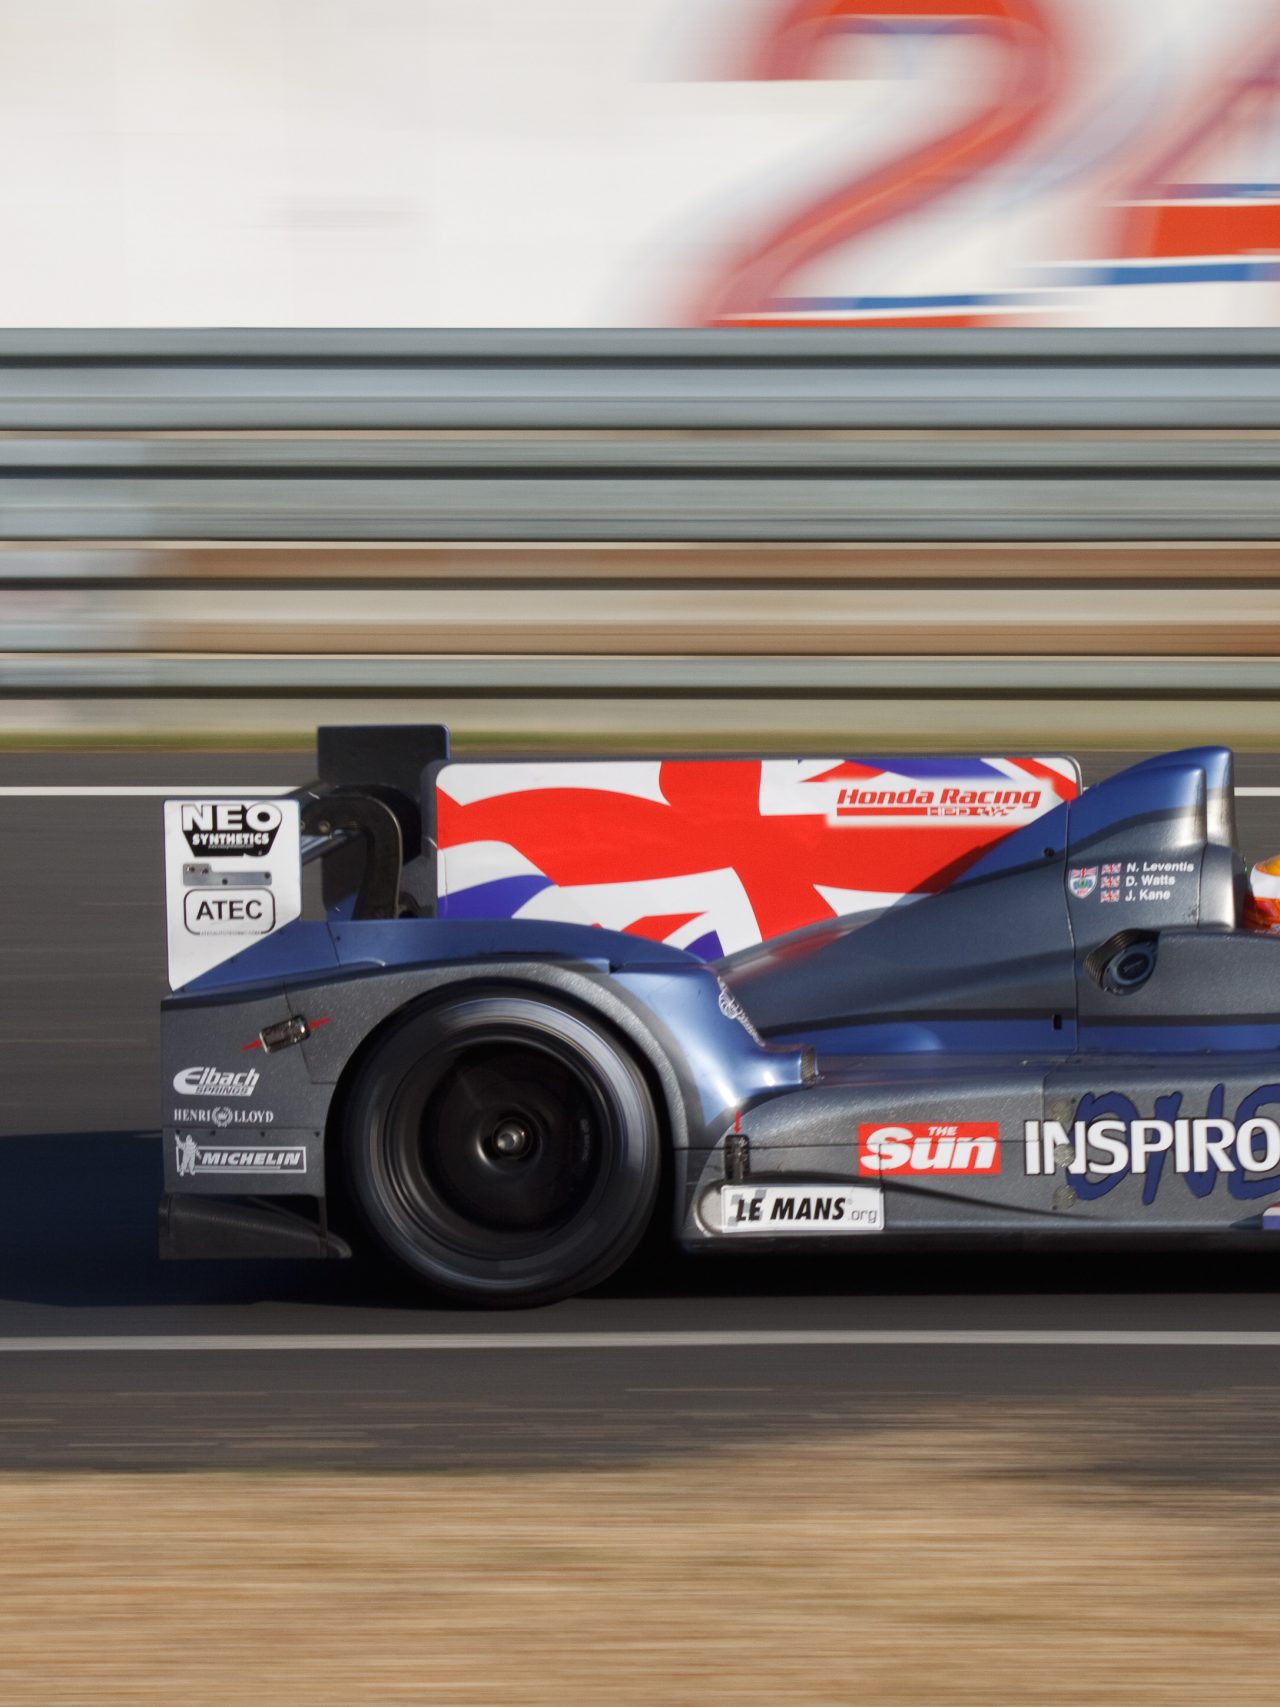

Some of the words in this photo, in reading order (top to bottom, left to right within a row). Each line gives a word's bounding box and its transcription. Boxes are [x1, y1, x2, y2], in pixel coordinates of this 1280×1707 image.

[836, 788, 935, 805] Honda
[939, 788, 1041, 809] Racing
[181, 802, 282, 832] NEO
[192, 832, 270, 846] SYNTHETICS
[1126, 862, 1139, 873] N.
[1143, 861, 1194, 873] Leventis
[1125, 876, 1138, 887] D.
[1141, 874, 1176, 887] Watts
[1125, 890, 1136, 902] J.
[1139, 889, 1171, 901] Kane
[196, 900, 262, 920] ATEC
[174, 1108, 211, 1121] HENRI
[234, 1110, 274, 1123] LLOYD
[928, 1126, 958, 1136] THE
[860, 1127, 997, 1170] Sun
[201, 1152, 301, 1166] MICHELIN
[736, 1199, 761, 1222] LE
[770, 1197, 846, 1221] MANS
